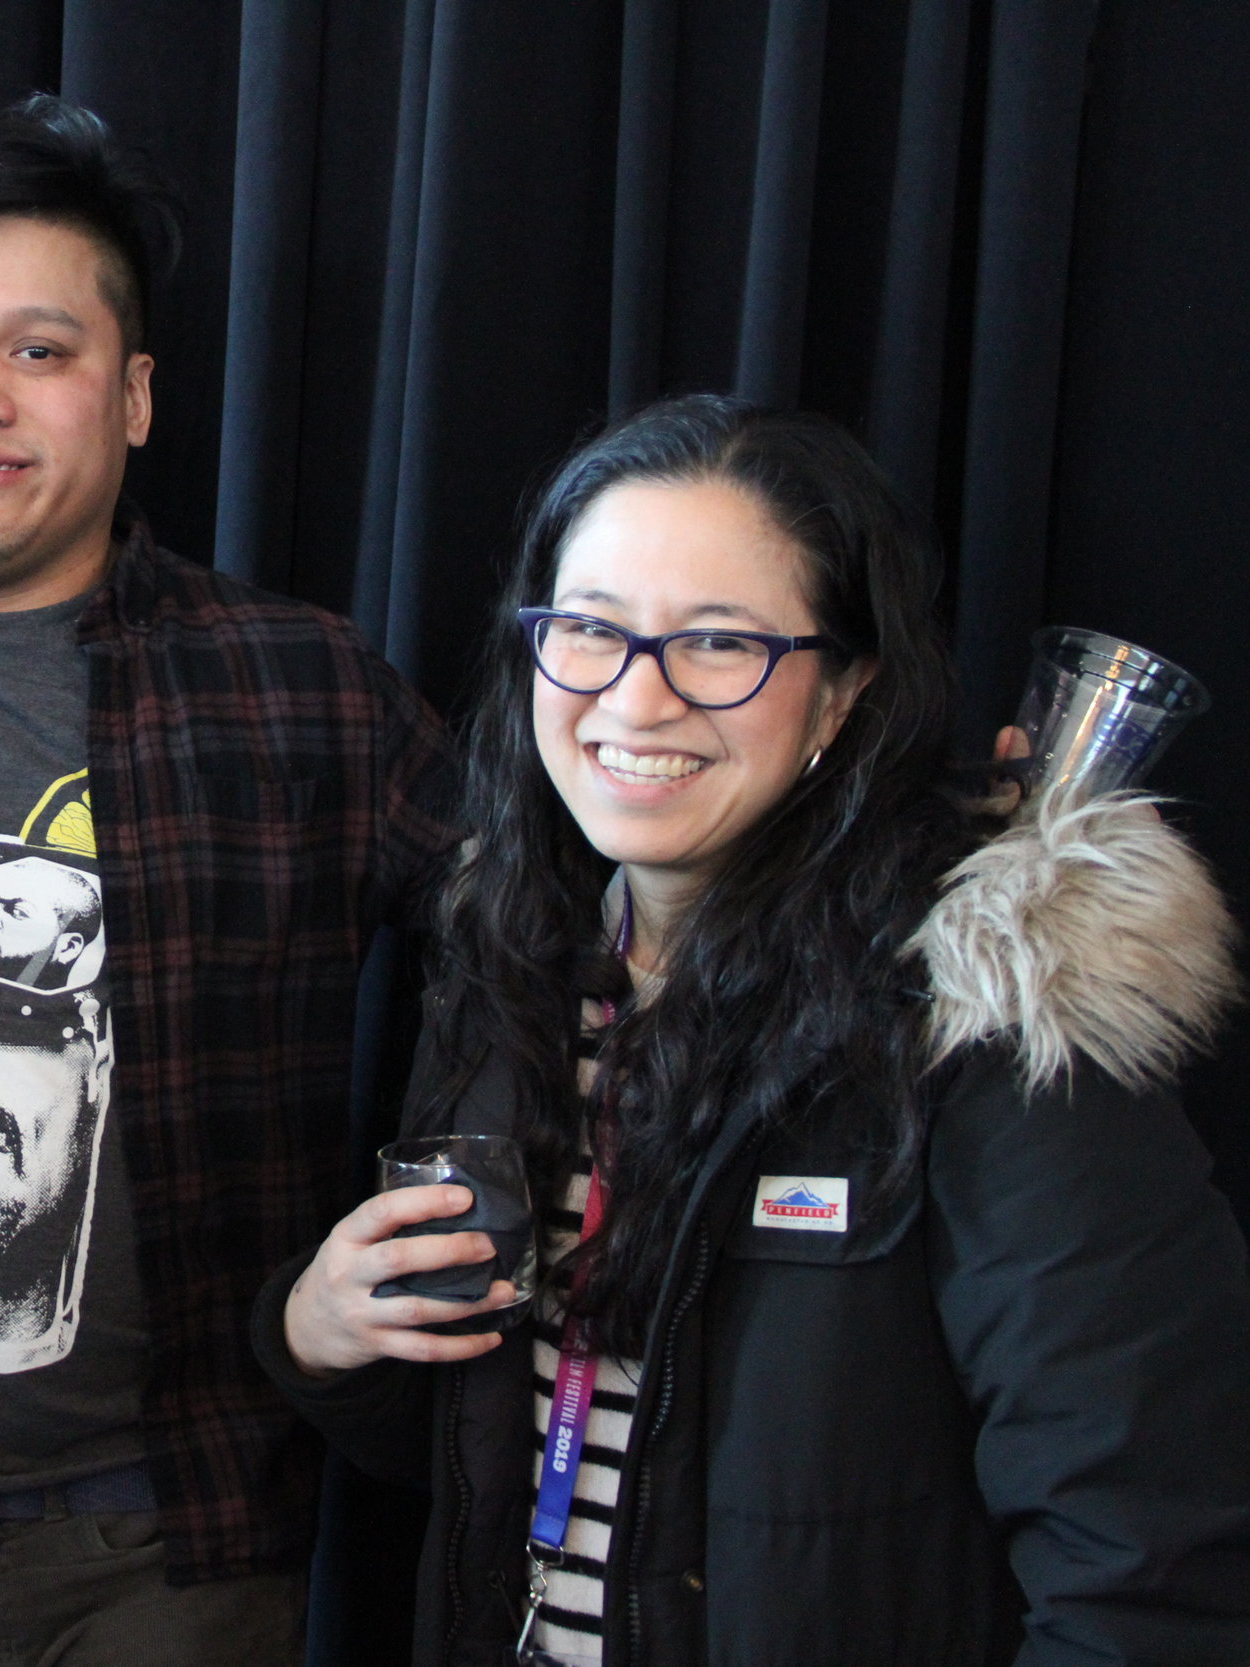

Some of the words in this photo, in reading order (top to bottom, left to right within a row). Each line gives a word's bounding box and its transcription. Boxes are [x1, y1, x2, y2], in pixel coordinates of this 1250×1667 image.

[769, 1206, 830, 1217] PENFIELD
[560, 1378, 583, 1425] FESTIVAL
[553, 1425, 573, 1473] 2019
